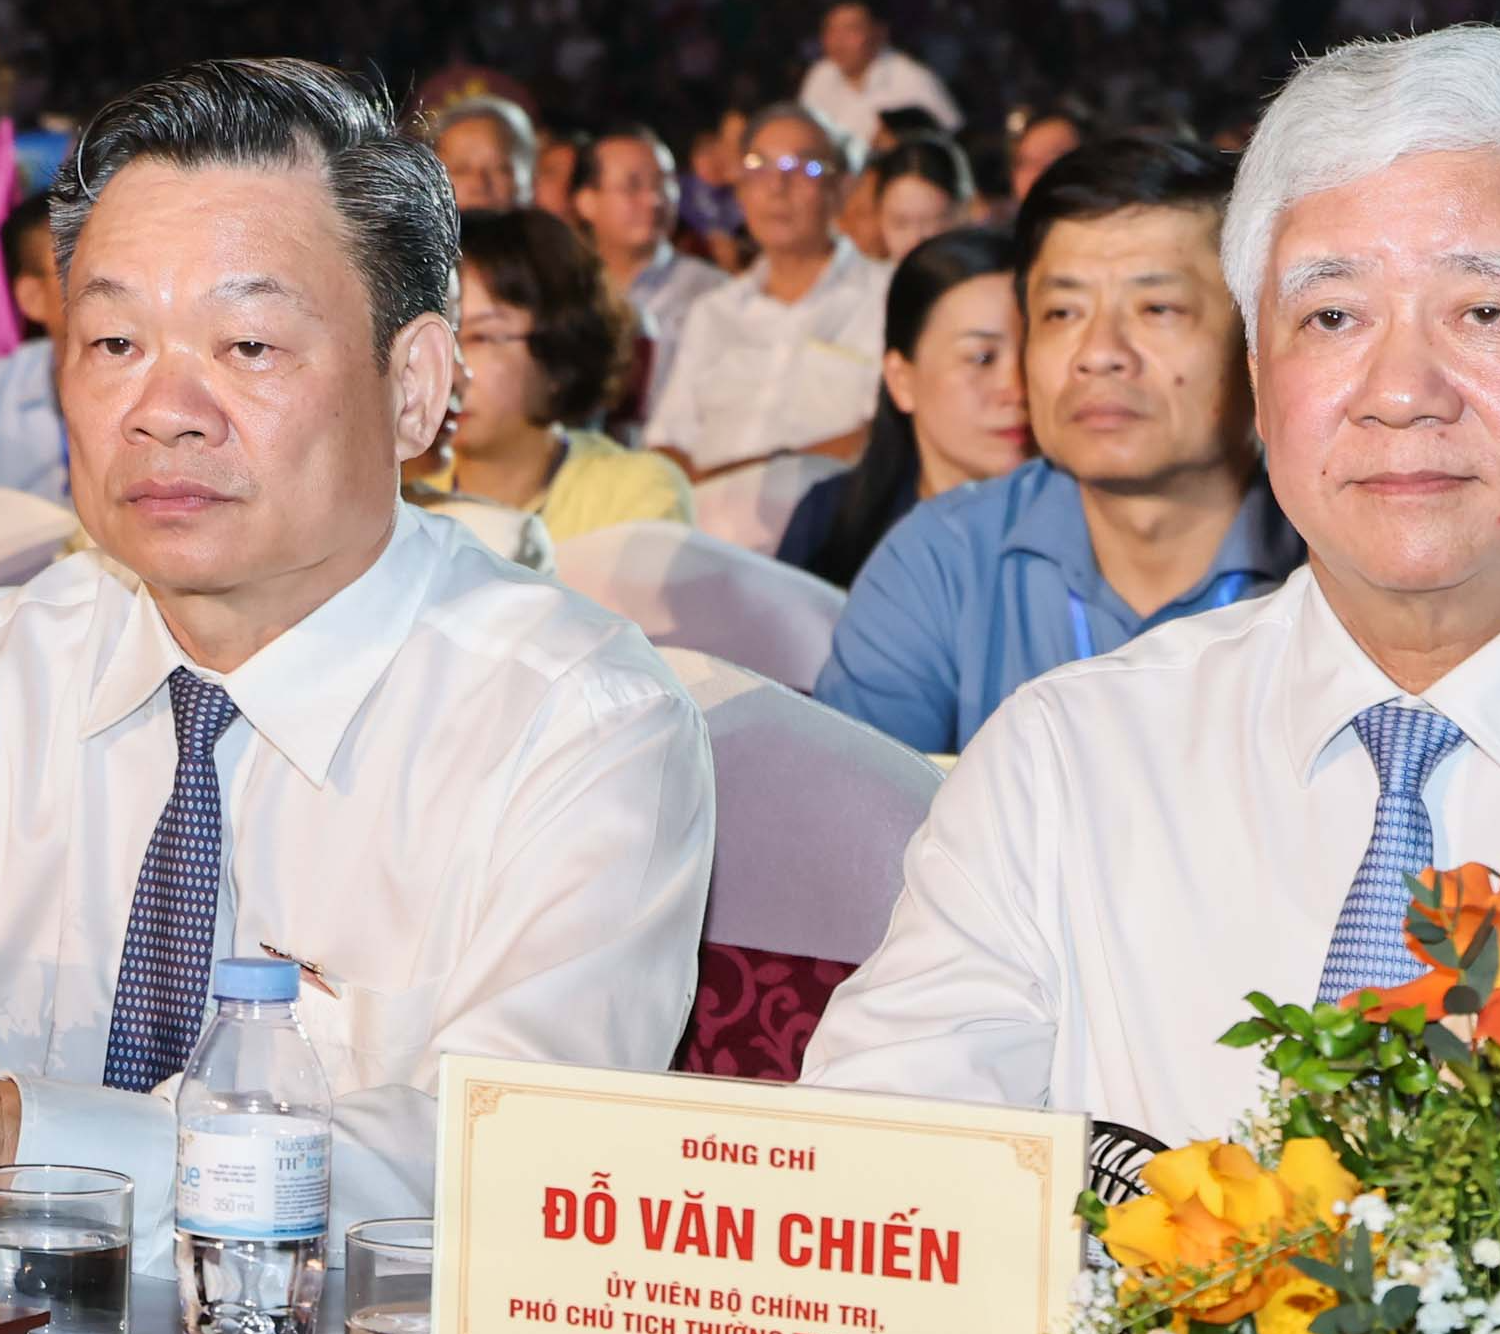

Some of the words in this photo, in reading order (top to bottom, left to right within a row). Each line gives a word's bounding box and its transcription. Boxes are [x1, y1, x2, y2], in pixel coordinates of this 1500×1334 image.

[681, 1132, 759, 1166] ĐỒNG
[769, 1142, 816, 1172] CHÍ
[542, 1171, 617, 1245] ĐỖ
[639, 1188, 755, 1260] VĂN
[778, 1205, 960, 1285] CHIẾN
[509, 1298, 557, 1322] PHÓ
[566, 1302, 613, 1329] CHỦ
[606, 1270, 636, 1299] ỦY
[645, 1280, 700, 1307] VIÊN
[709, 1288, 741, 1317] BỘ
[751, 1293, 828, 1323] CHÍNH
[838, 1304, 885, 1334] TRỊ,
